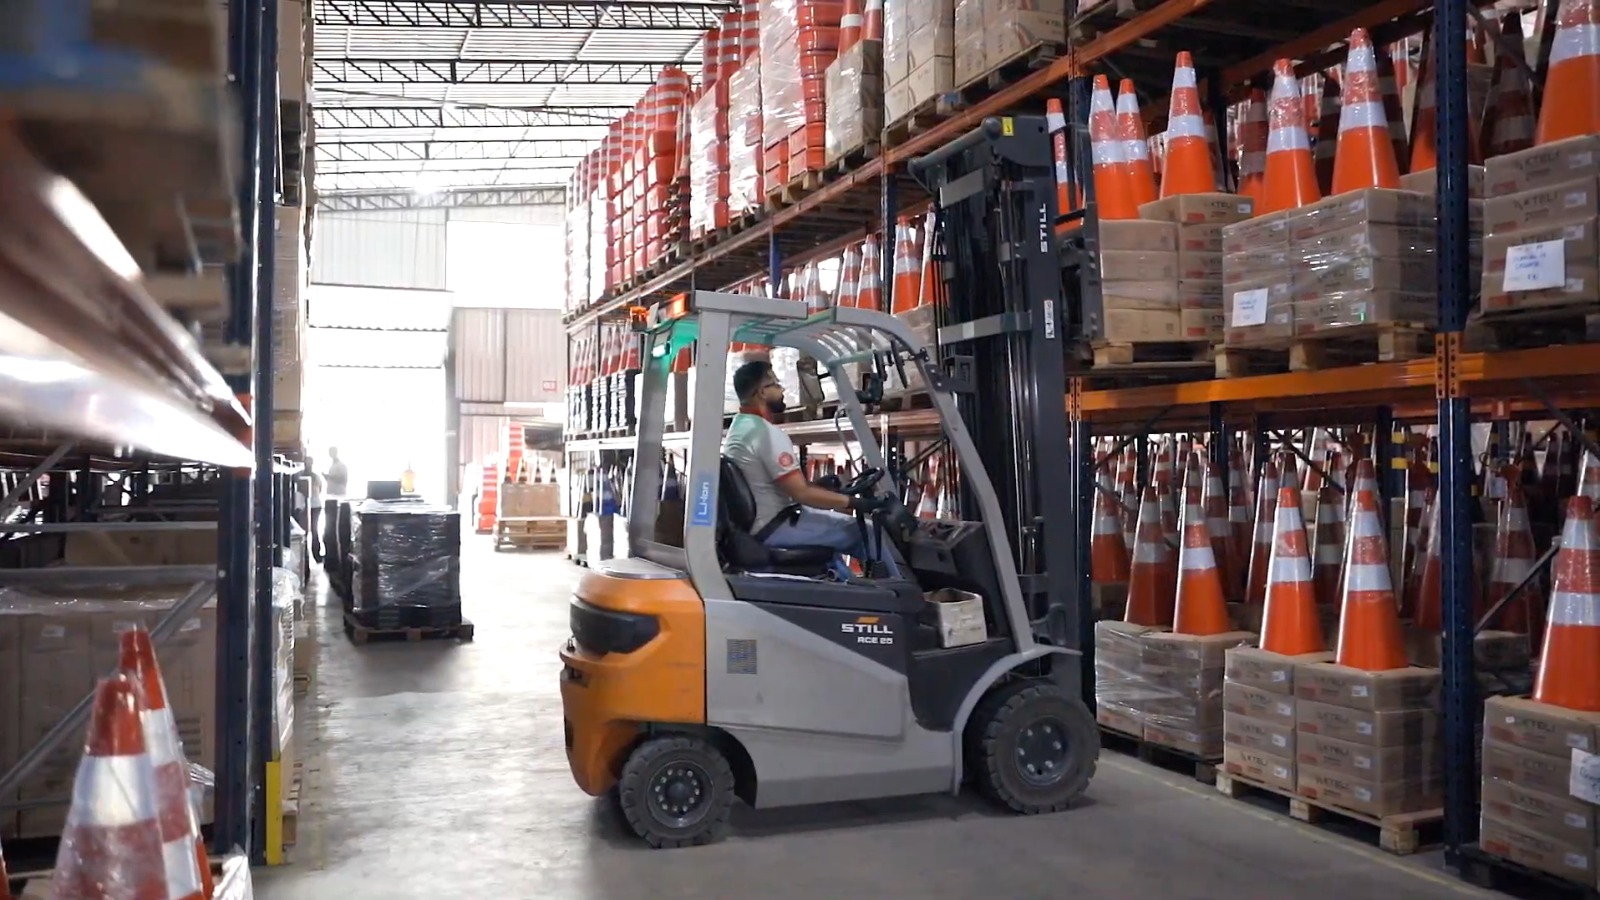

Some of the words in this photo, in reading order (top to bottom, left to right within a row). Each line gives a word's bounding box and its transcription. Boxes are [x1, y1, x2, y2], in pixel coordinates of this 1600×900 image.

[1038, 203, 1048, 253] STILL
[841, 623, 894, 634] STILL
[880, 637, 893, 645] 25
